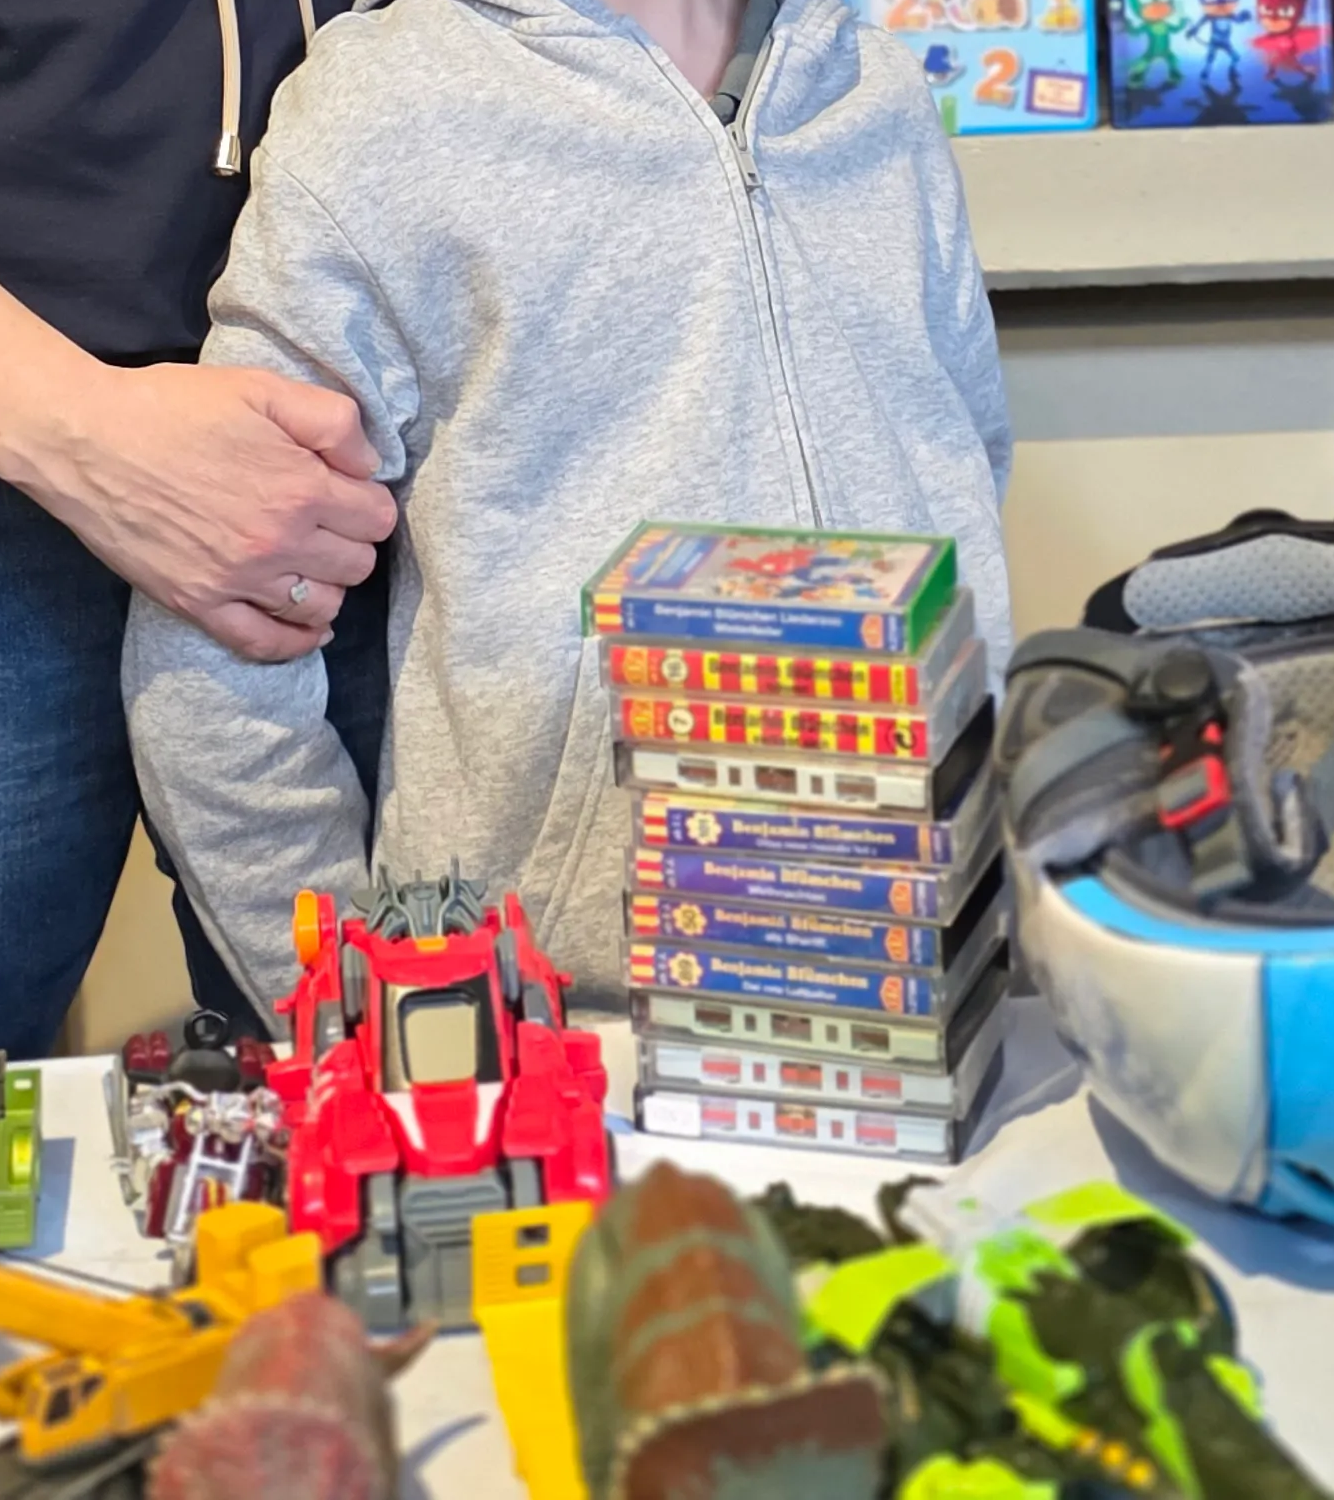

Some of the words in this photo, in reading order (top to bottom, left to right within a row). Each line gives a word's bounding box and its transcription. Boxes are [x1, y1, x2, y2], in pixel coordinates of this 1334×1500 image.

[654, 603, 712, 619] Benjamin
[732, 818, 810, 840] Benjamin
[814, 822, 896, 845] Blümchen
[704, 861, 776, 883] Benjamin
[780, 868, 863, 891] Blümchen
[714, 908, 786, 928] Benjamin
[791, 912, 873, 937] Blümchen
[711, 957, 782, 979] Benjamin
[787, 965, 869, 989] Blümchen
